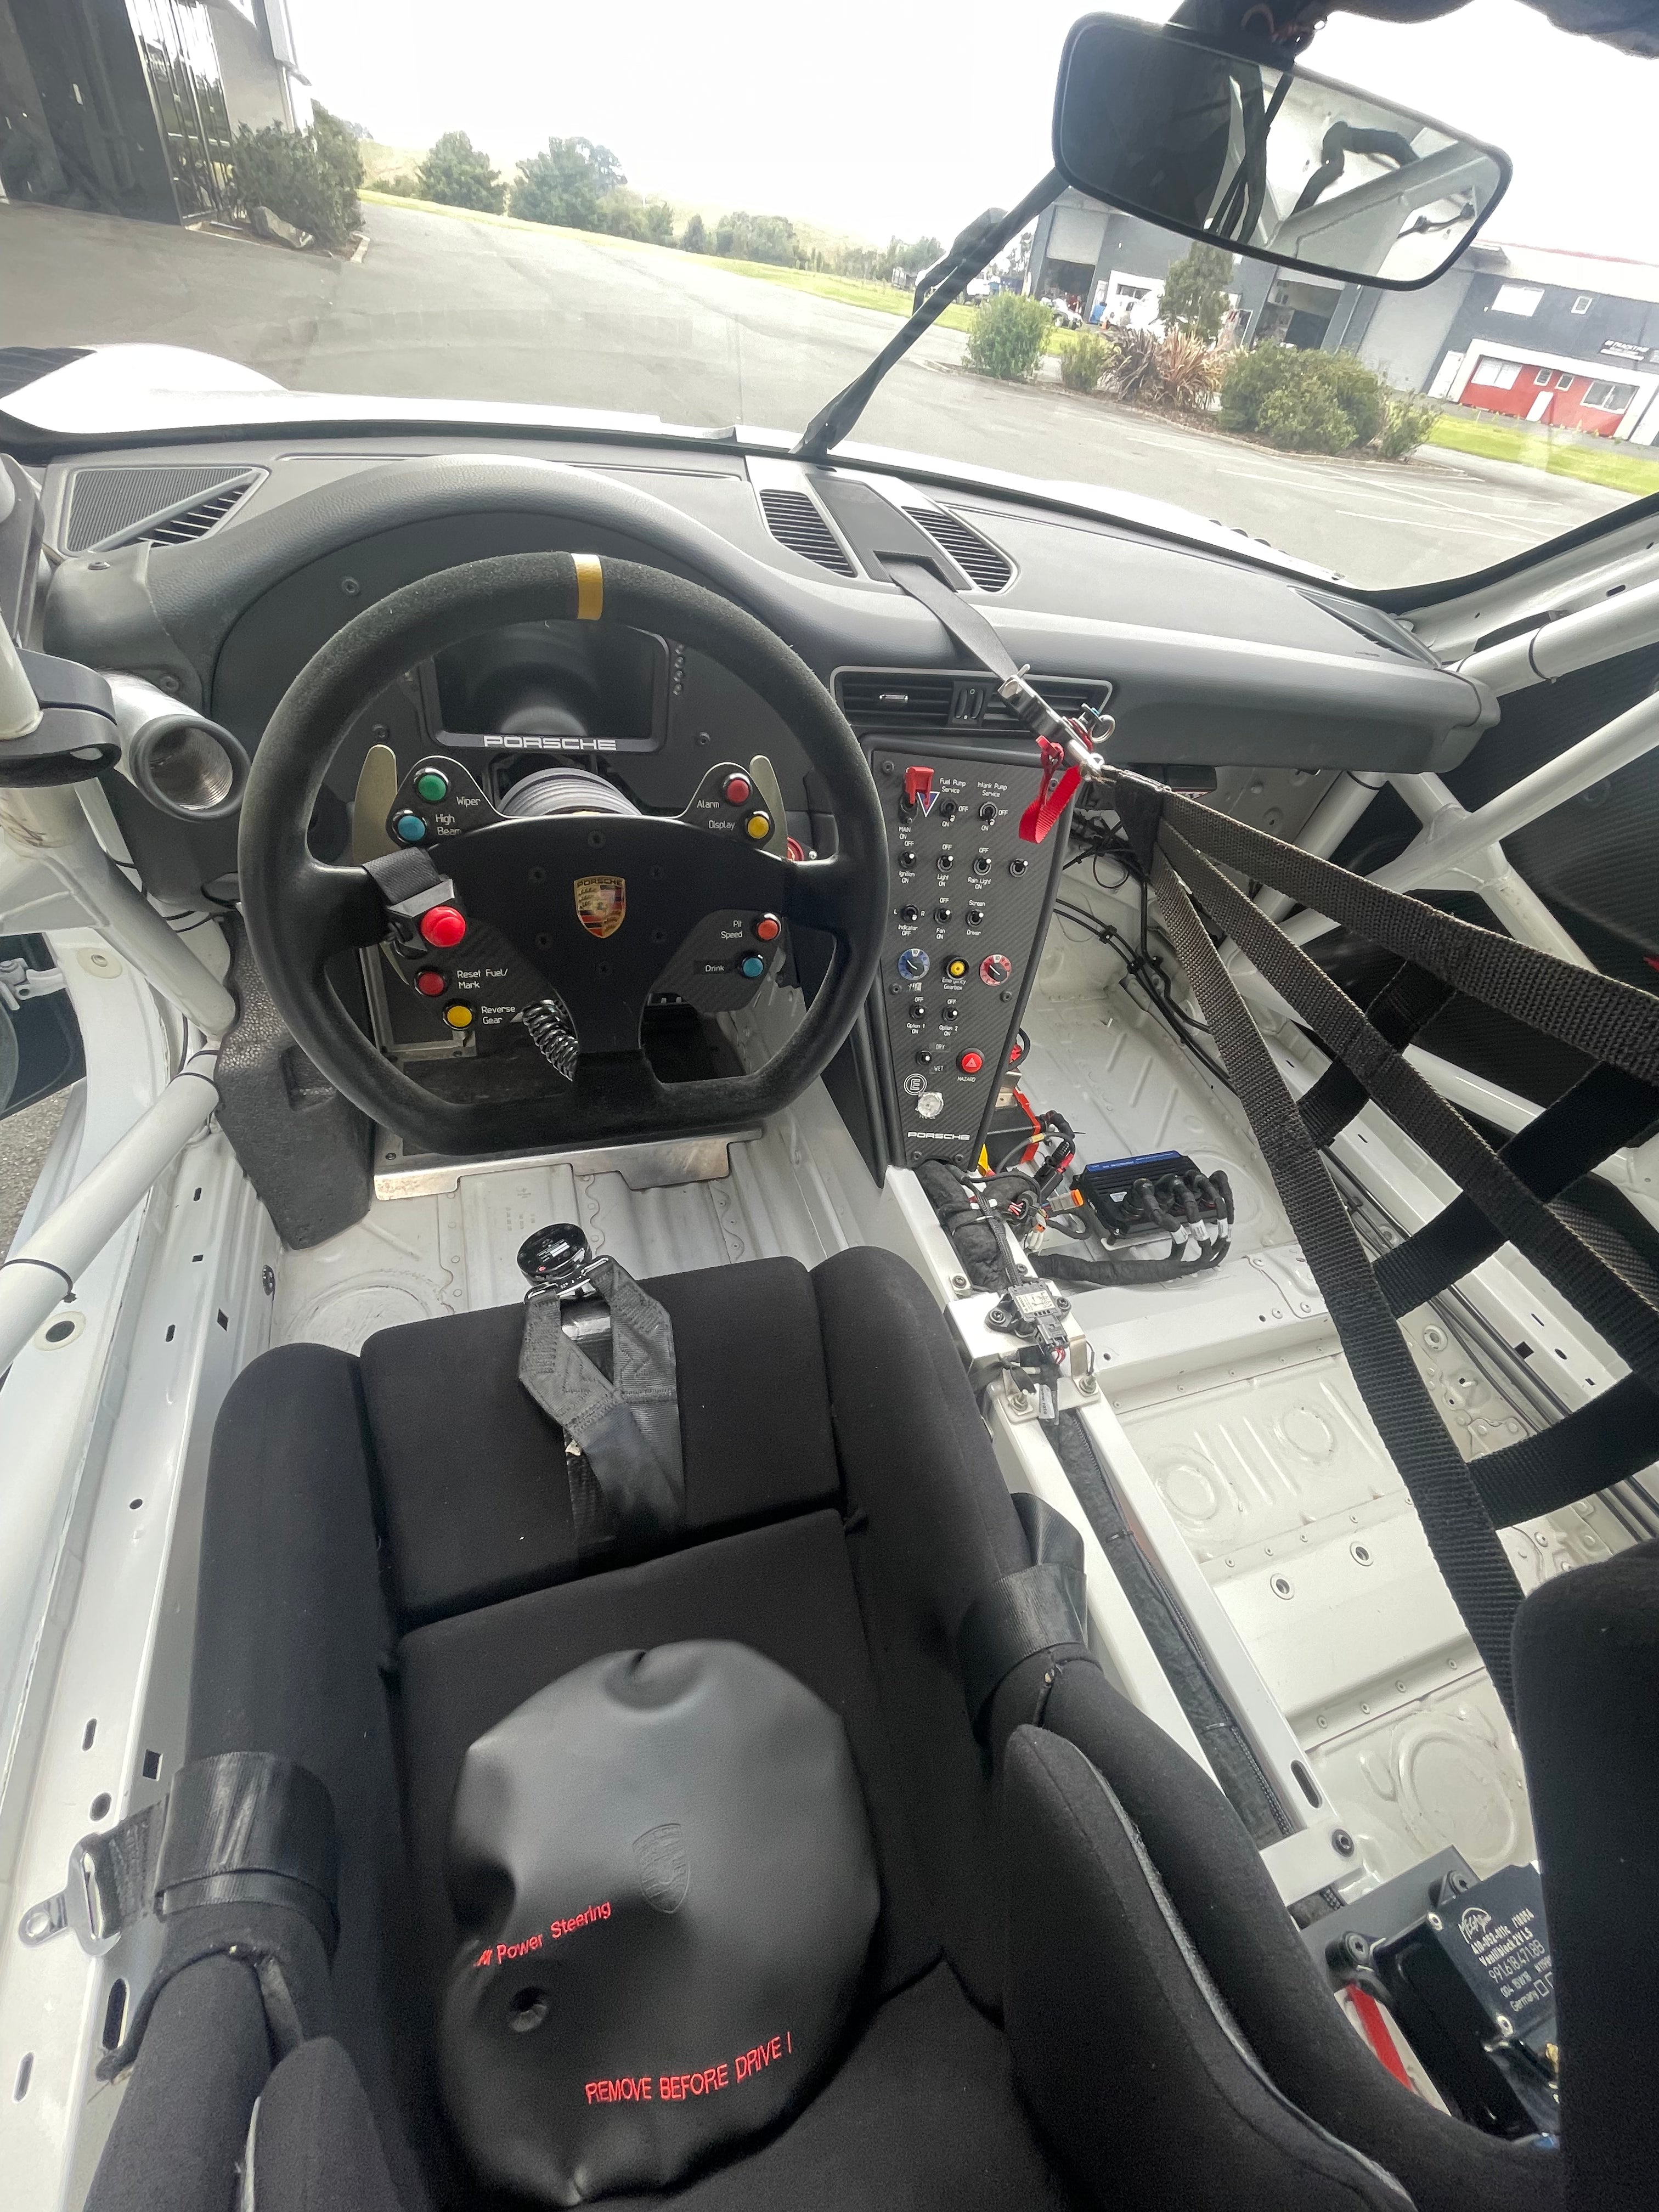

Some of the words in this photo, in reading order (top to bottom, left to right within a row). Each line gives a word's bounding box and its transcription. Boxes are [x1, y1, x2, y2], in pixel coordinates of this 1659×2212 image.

[483, 736, 617, 751] PORSCHE
[952, 779, 966, 788] Pump
[994, 783, 1007, 791] Pump
[982, 789, 1000, 798] Service
[456, 796, 481, 808] Wiper
[697, 799, 720, 809] Alarm
[435, 814, 455, 824] High
[708, 820, 735, 831] Display
[437, 826, 461, 836] Beam
[577, 878, 623, 887] PORSCHE
[721, 930, 743, 939] Speed
[457, 969, 481, 978] Reset
[486, 968, 508, 977] Fuel/
[458, 981, 481, 989] Mark
[482, 1017, 503, 1025] Gear
[907, 1131, 970, 1141] PORSCHE
[496, 1934, 543, 1964] Power
[550, 1901, 612, 1939] Steering
[1510, 1990, 1540, 2012] Germany
[585, 2077, 652, 2104] REMOVE
[659, 2064, 729, 2101] BEFORE
[735, 2036, 782, 2084] DRIVE
